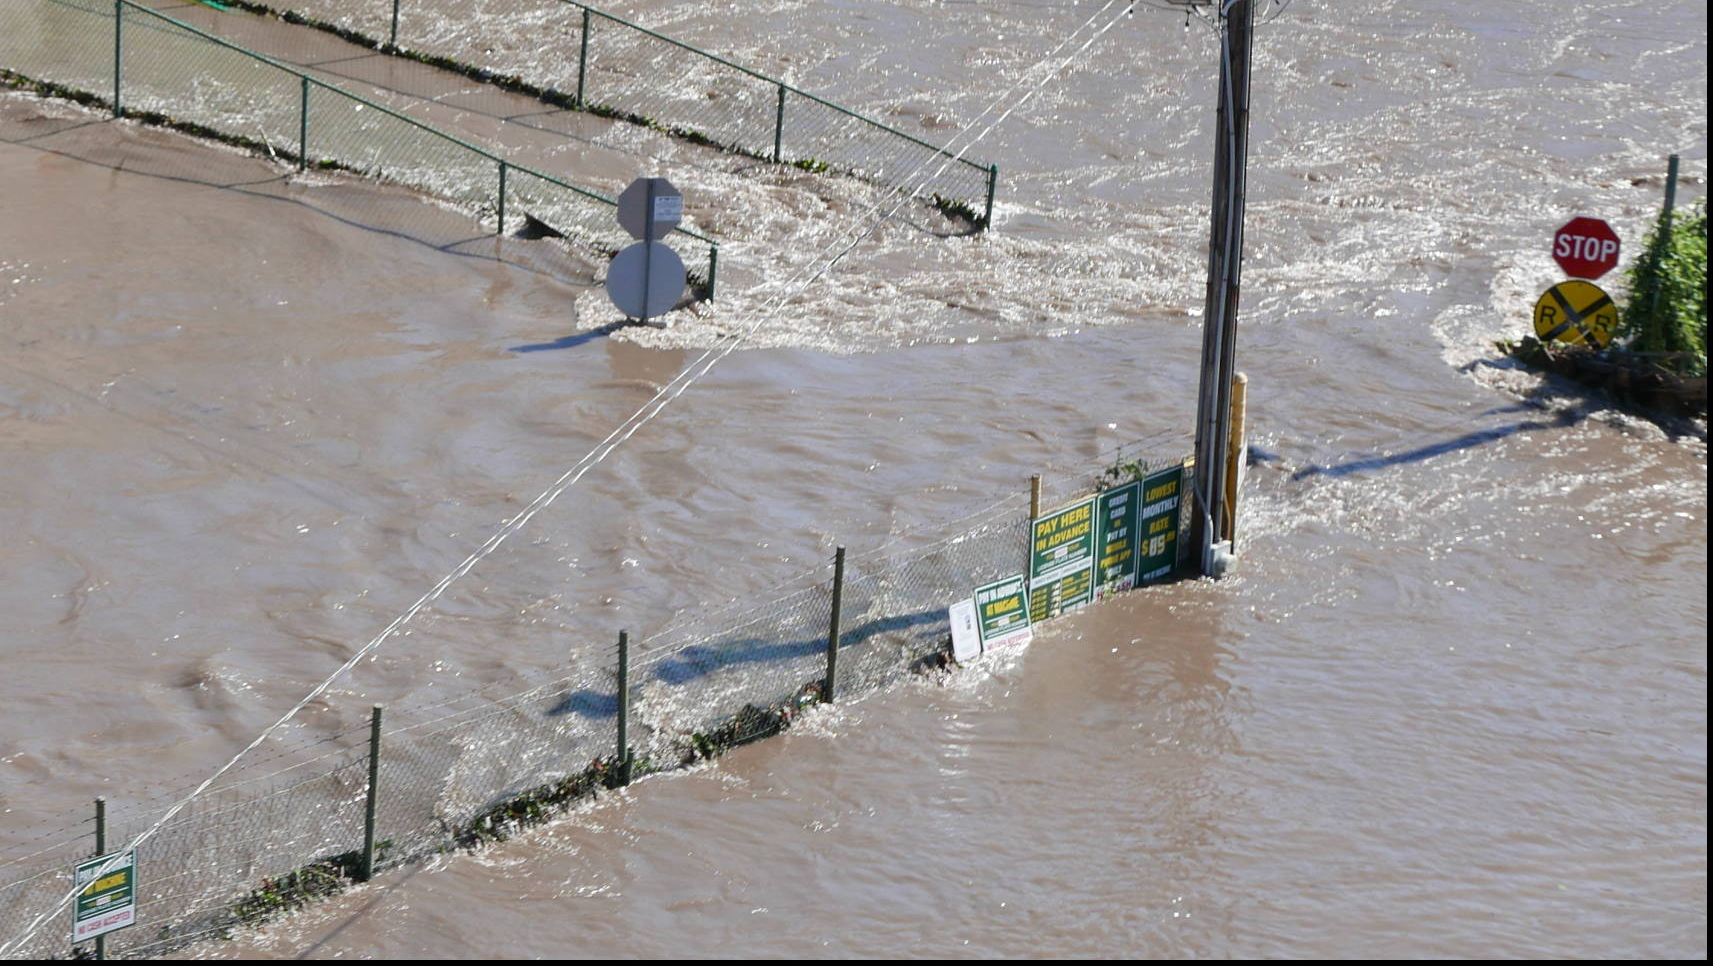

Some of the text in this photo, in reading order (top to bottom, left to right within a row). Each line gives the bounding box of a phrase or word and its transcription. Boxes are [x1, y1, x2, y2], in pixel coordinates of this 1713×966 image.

[1556, 233, 1617, 263] STOP
[1539, 305, 1611, 332] R R
[1146, 481, 1177, 502] LOWEST
[1037, 504, 1090, 538] PAY HERE
[1143, 496, 1179, 519] MONTHLY
[1036, 537, 1047, 552] IN
[1048, 521, 1090, 547] ADVANCE
[1107, 530, 1119, 543] PAY
